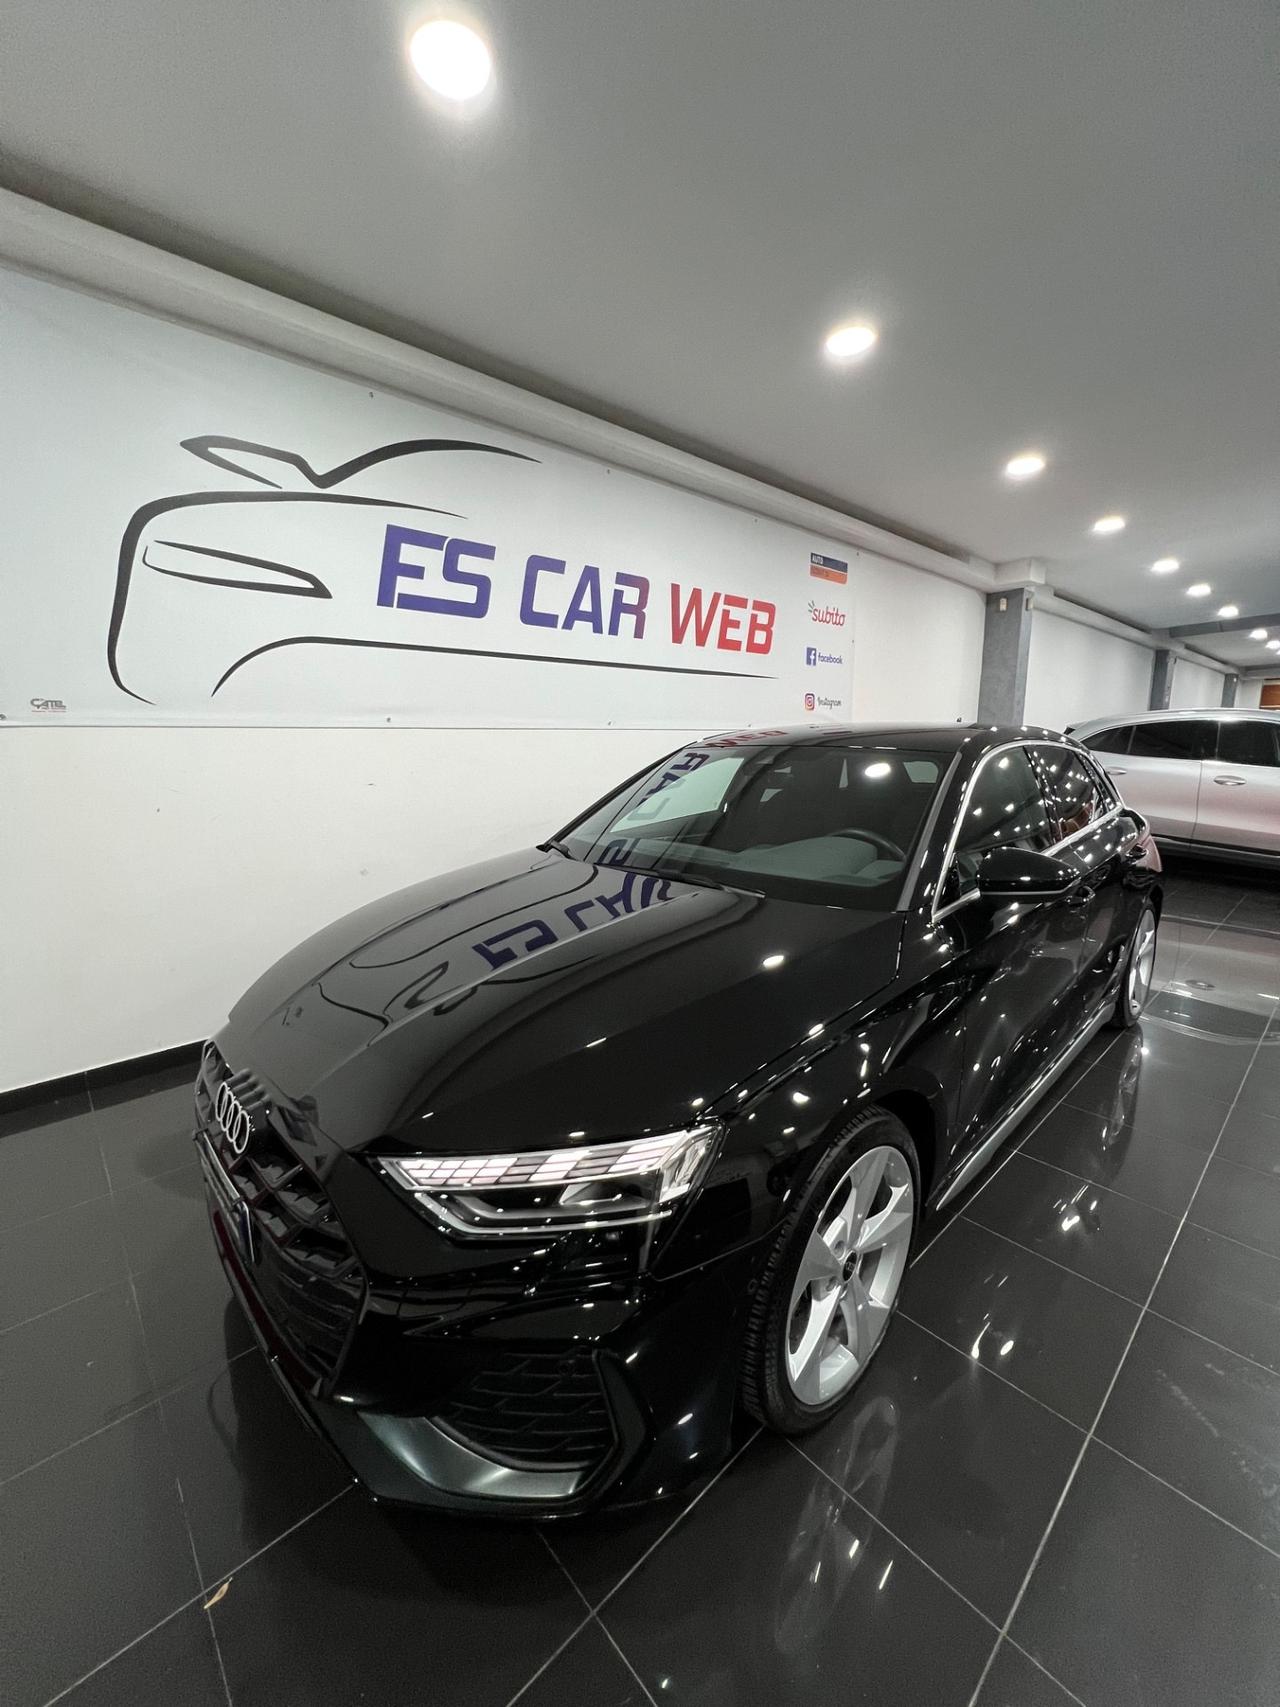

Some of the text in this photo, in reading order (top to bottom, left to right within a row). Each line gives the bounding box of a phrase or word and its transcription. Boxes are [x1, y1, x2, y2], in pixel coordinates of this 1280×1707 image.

[377, 524, 776, 655] ES CAR WEB
[812, 606, 845, 626] subito
[818, 652, 843, 665] facebook
